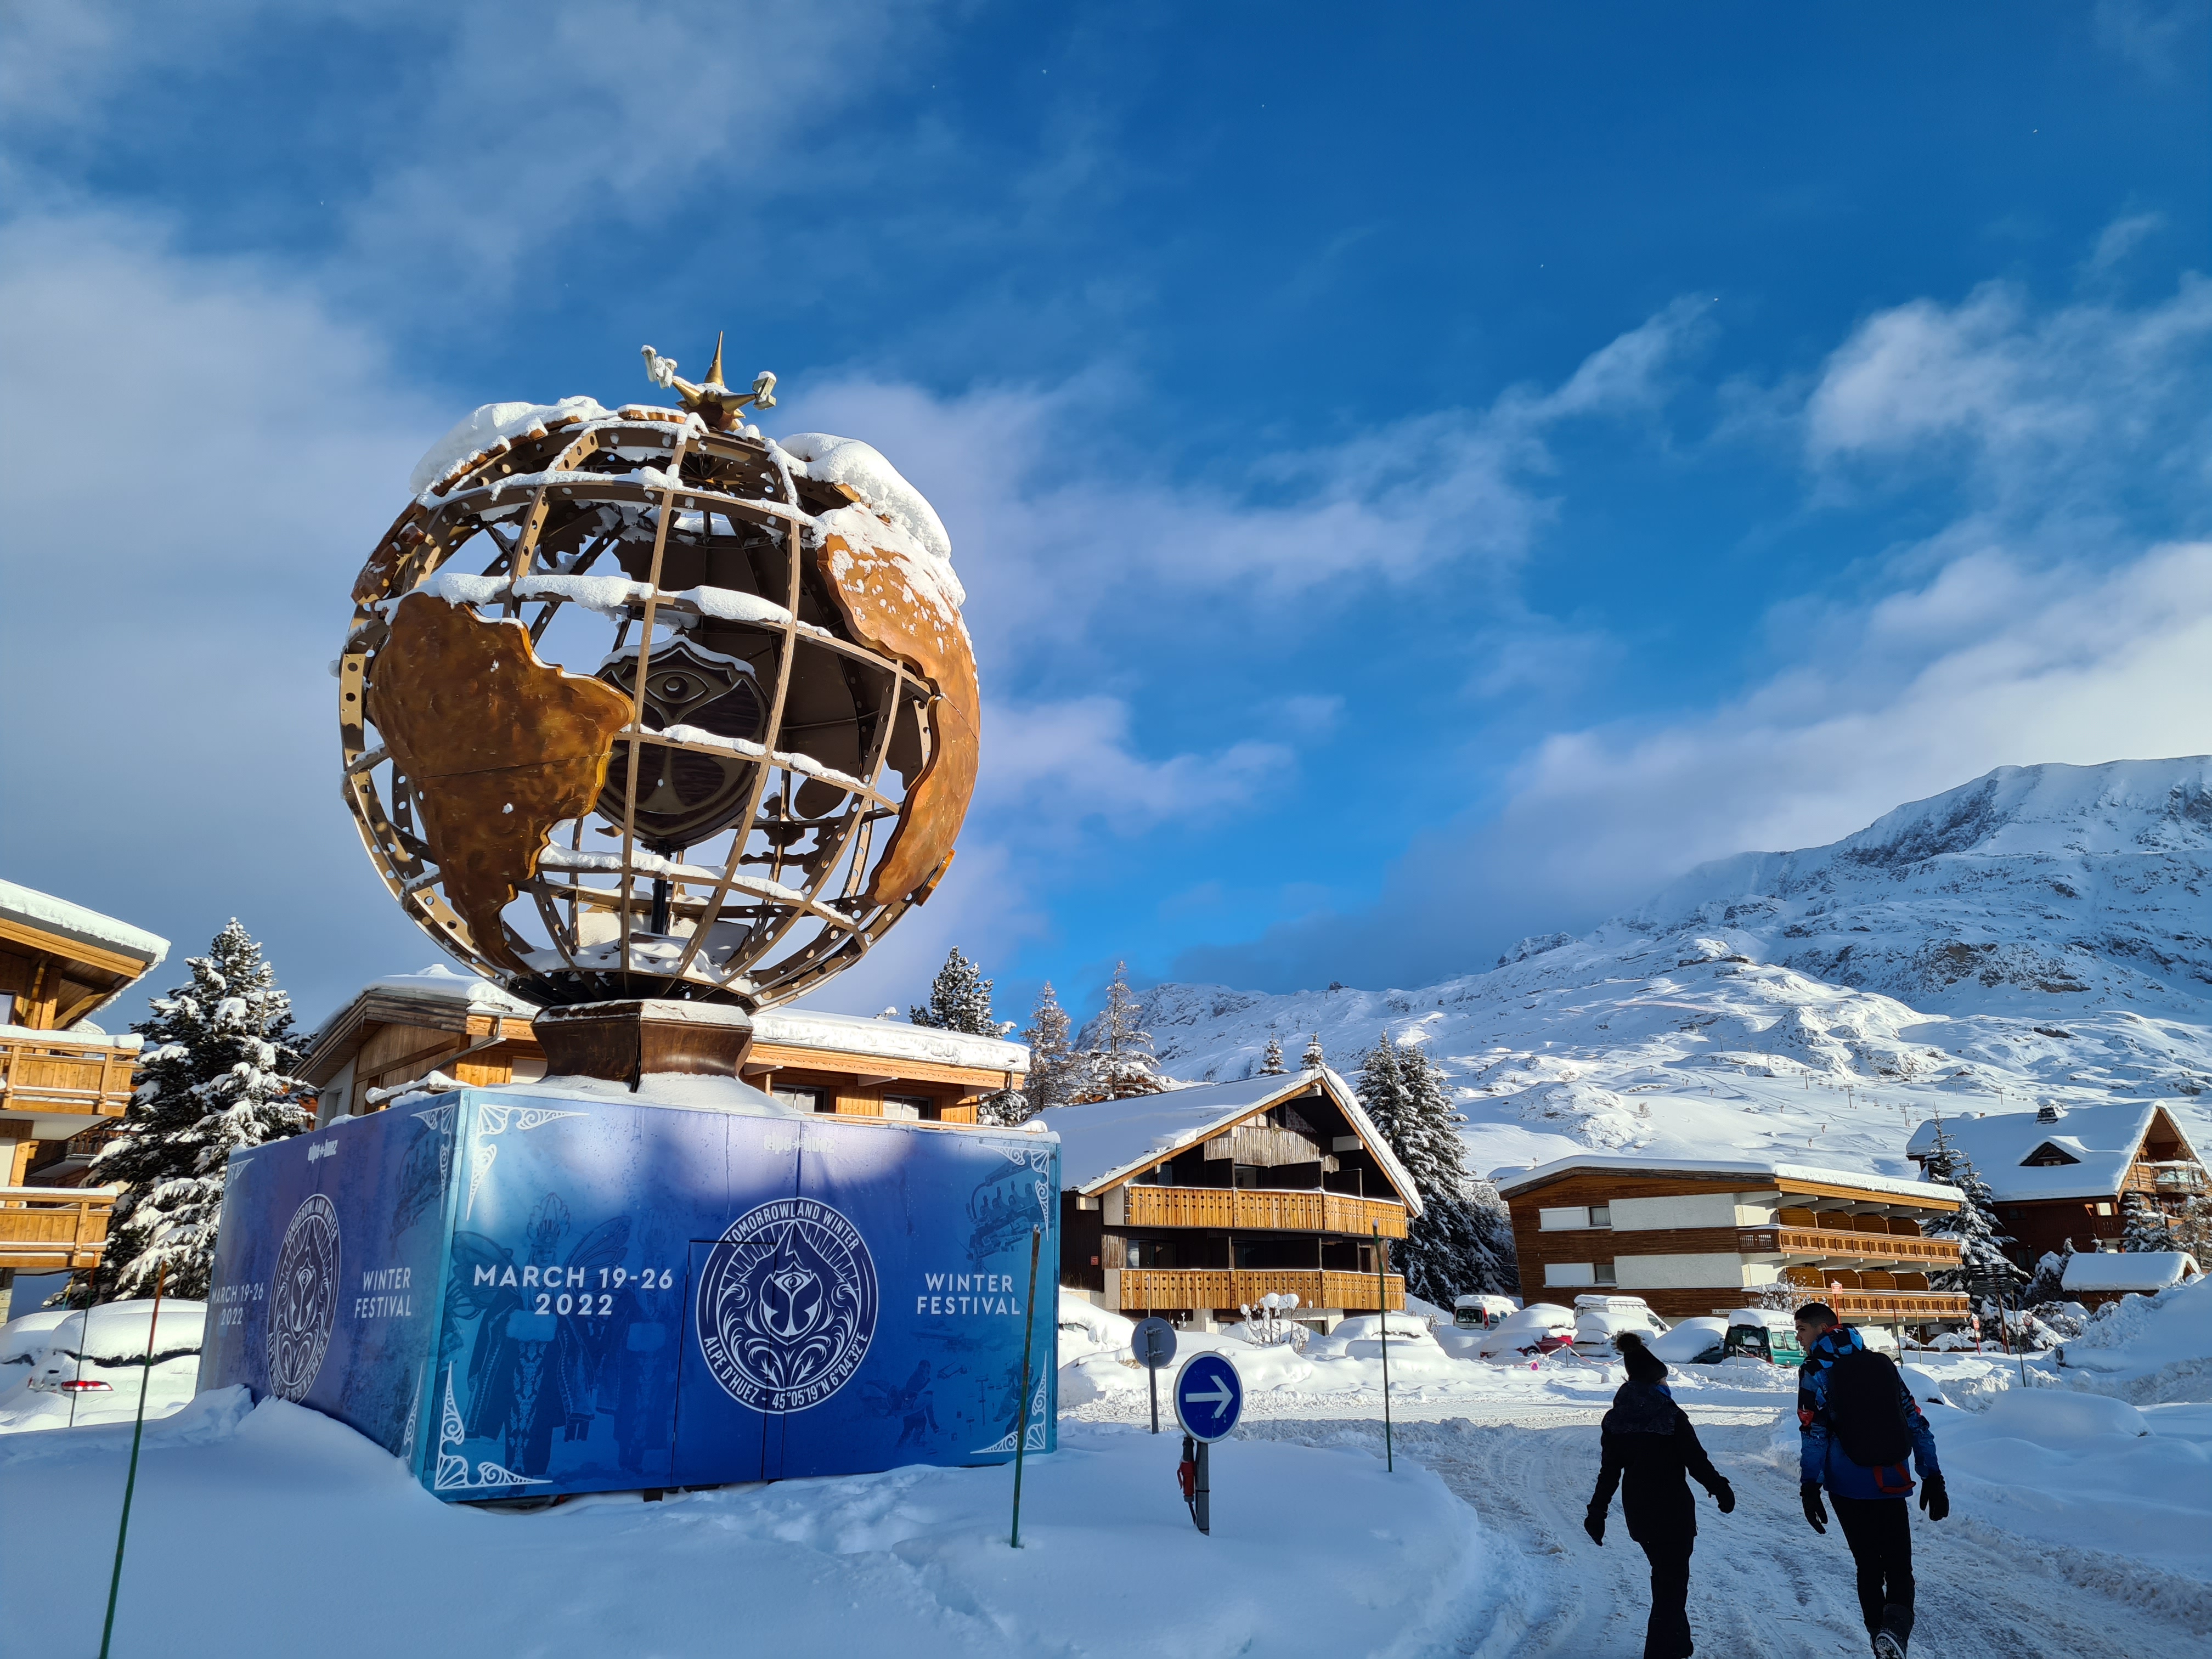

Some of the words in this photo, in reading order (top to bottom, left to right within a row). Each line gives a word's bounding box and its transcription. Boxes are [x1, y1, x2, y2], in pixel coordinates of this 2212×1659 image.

[285, 1199, 325, 1247] TOMORROWLAND
[324, 1203, 337, 1243] WINTER
[725, 1201, 820, 1248] TOMORROWLAND
[823, 1210, 859, 1250] WINTER
[363, 1267, 411, 1291] WINTER
[473, 1265, 585, 1288] MARCH
[600, 1268, 673, 1290] 19-26
[926, 1273, 1013, 1293] WINTER
[211, 1285, 238, 1304] MARCH
[241, 1282, 264, 1301] 19-26
[221, 1307, 243, 1325] 2022
[354, 1295, 411, 1318] FESTIVAL
[534, 1294, 613, 1316] 2022
[917, 1296, 1020, 1316] FESTIVAL
[704, 1336, 727, 1370] ALPE
[720, 1365, 760, 1403] D'HUEZ
